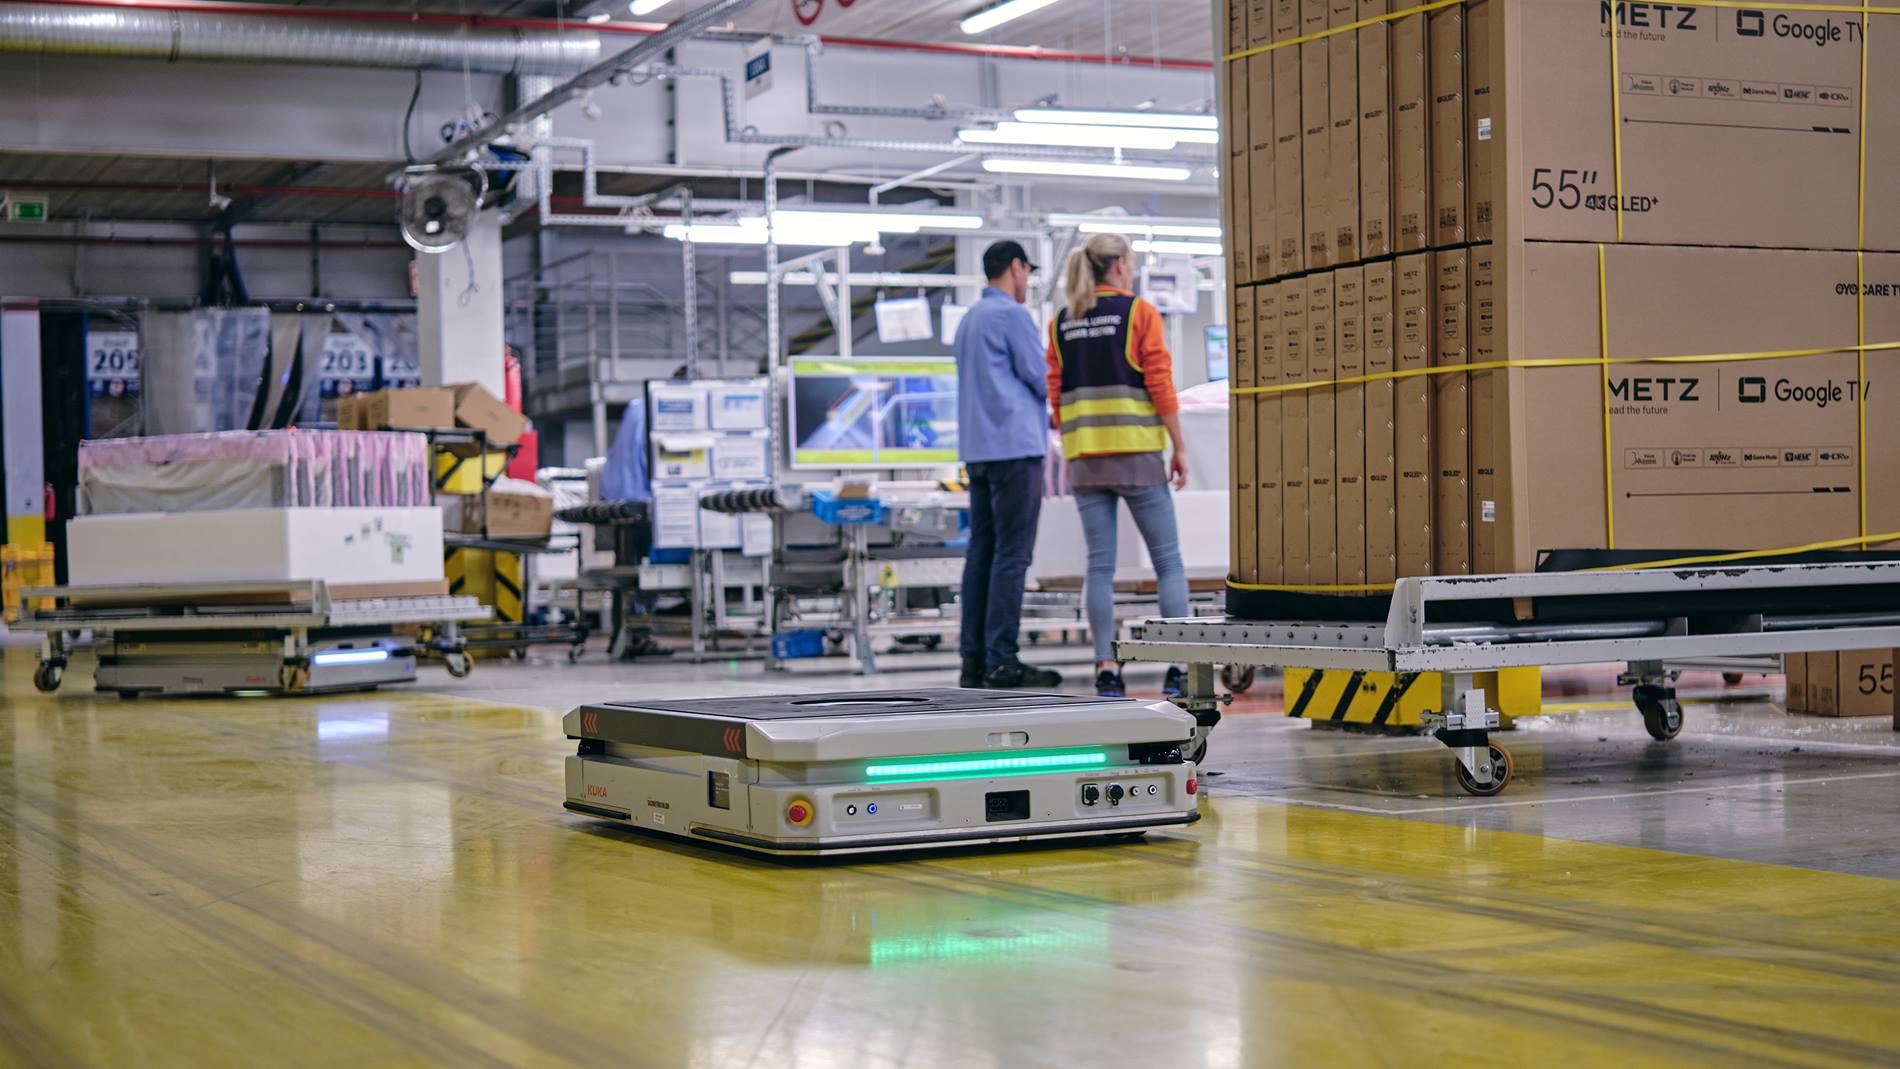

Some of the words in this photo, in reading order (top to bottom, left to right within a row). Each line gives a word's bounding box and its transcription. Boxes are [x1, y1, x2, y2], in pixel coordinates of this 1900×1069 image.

[1600, 1, 1697, 30] METZ
[1600, 28, 1621, 39] Led
[1623, 29, 1638, 39] the
[1639, 30, 1666, 41] future
[1773, 14, 1841, 46] Google
[1845, 21, 1869, 43] TV
[323, 350, 366, 372] 203
[1606, 378, 1699, 401] METZ
[1774, 378, 1842, 408] Google
[1603, 405, 1625, 415] ead
[1626, 405, 1640, 415] the
[1642, 405, 1668, 415] future
[1858, 664, 1893, 695] 55
[587, 784, 608, 798] KUKA
